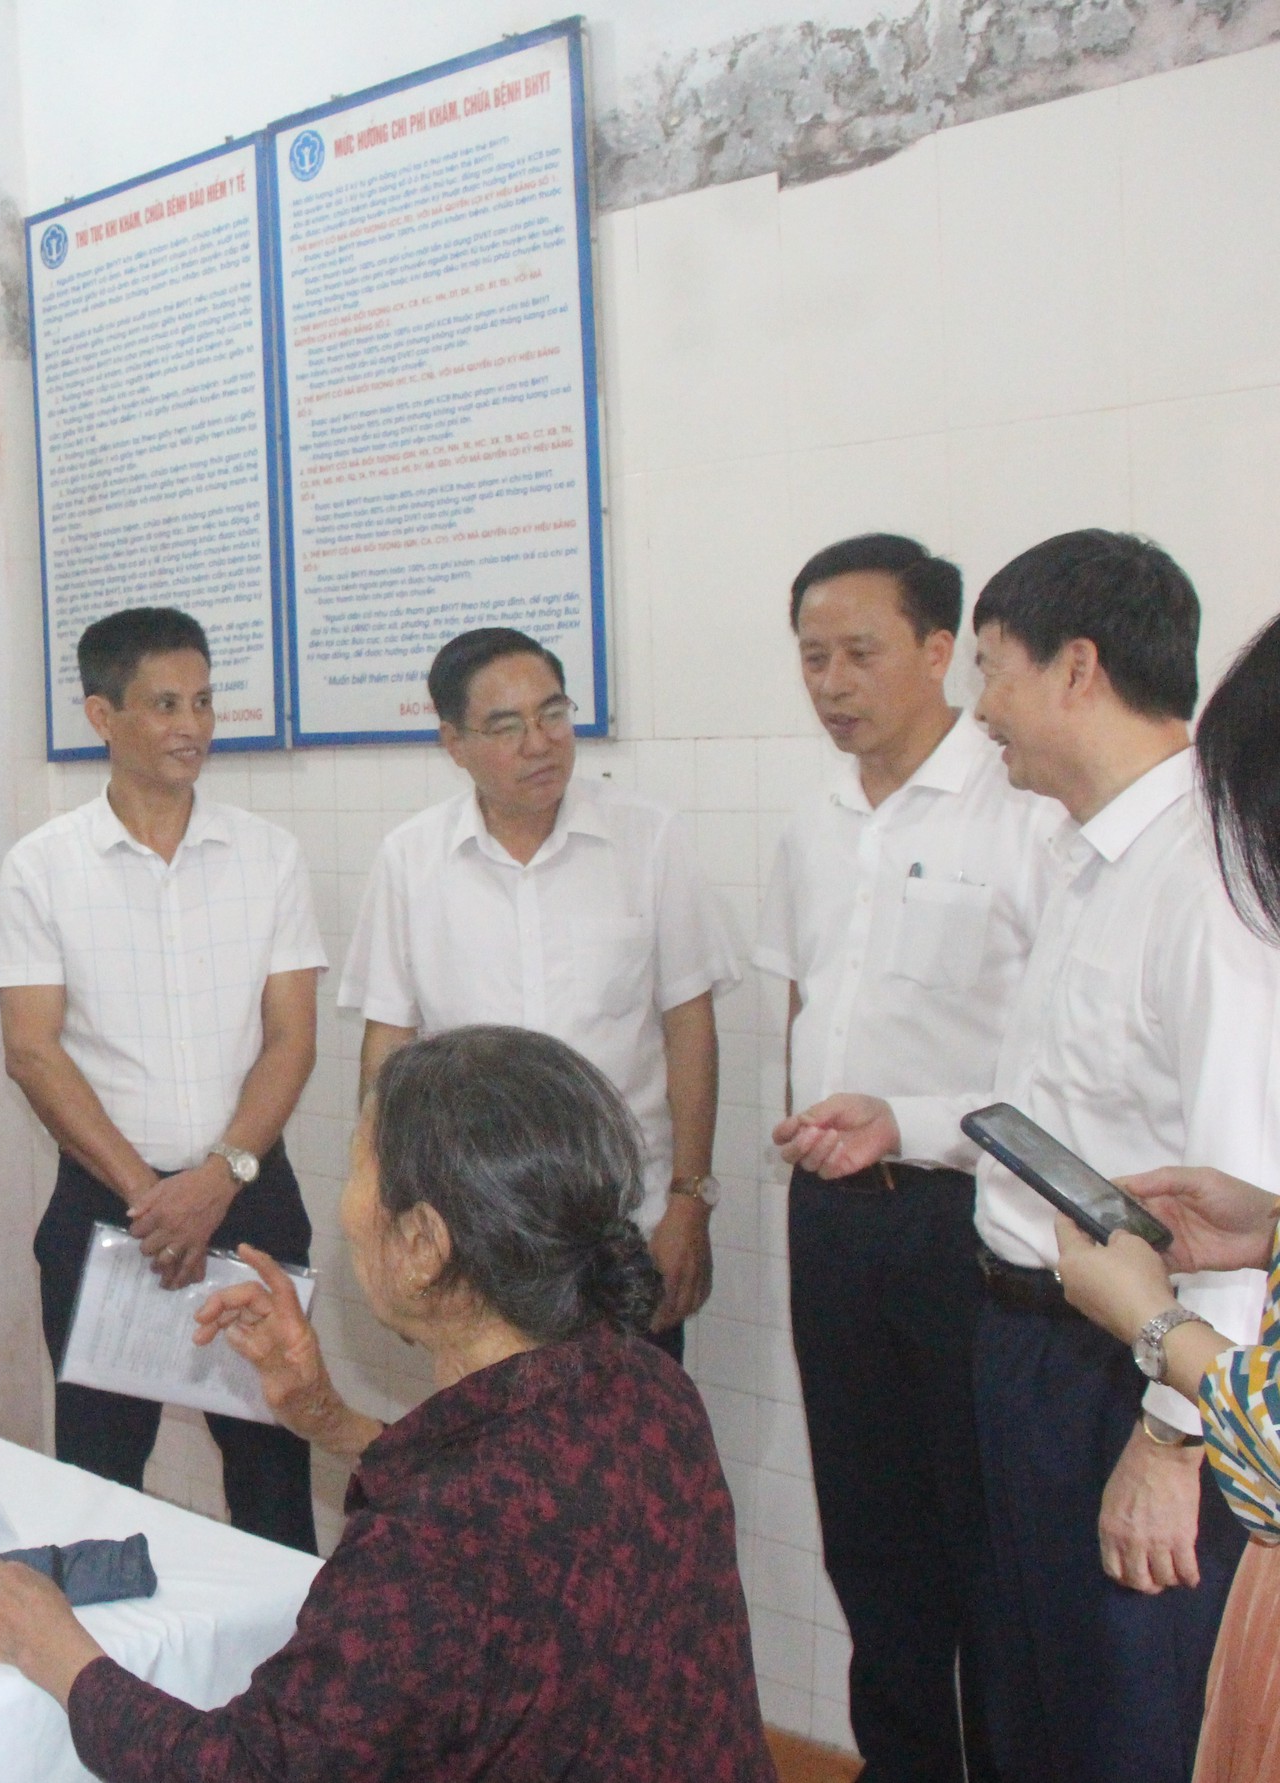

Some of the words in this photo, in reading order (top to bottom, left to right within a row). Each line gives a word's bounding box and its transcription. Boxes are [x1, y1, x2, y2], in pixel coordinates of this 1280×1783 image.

[357, 120, 388, 151] HƯỞNG
[391, 116, 407, 140] CHI
[409, 104, 425, 134] PHÍ
[428, 96, 461, 128] KHÁM,
[463, 85, 490, 118] CHỮA
[493, 77, 521, 111] BỆNH
[524, 69, 551, 98] BHYT
[105, 218, 117, 238] KHI
[166, 192, 187, 220] BỆNH
[228, 177, 234, 196] Y
[237, 168, 245, 193] TẾ
